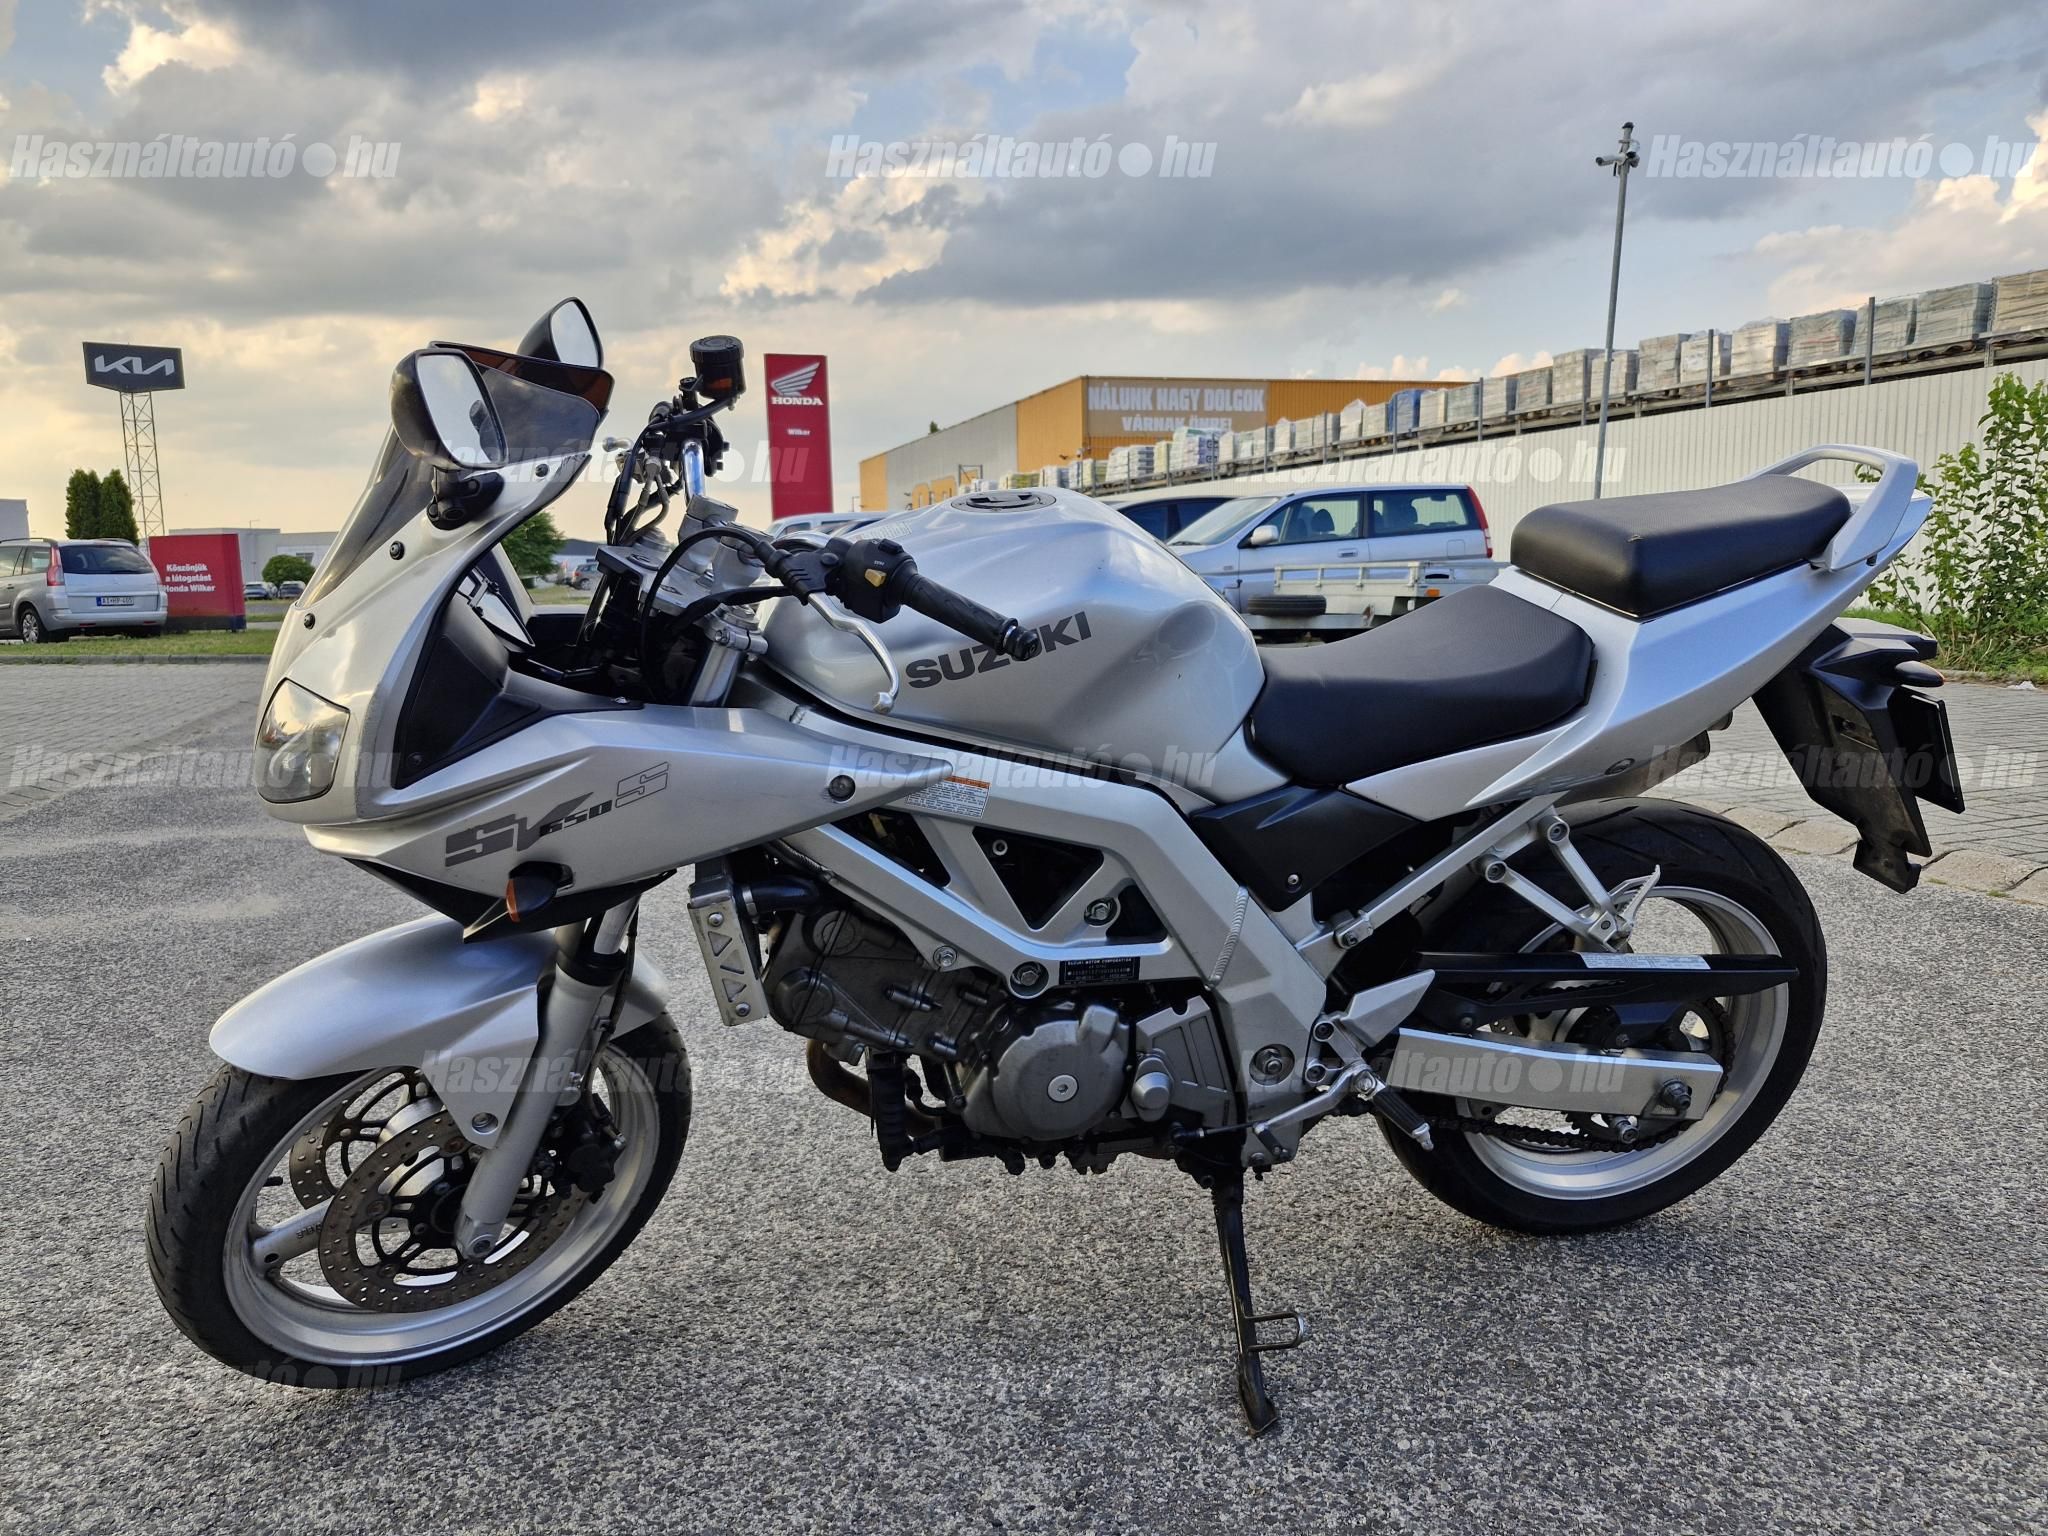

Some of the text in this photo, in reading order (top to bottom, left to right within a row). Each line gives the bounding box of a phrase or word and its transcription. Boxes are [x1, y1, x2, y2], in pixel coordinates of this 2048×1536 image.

[771, 397, 824, 406] HONDA
[1088, 382, 1152, 411] NÁLUNK
[1156, 388, 1200, 411] NAGY
[166, 564, 208, 573] Köszönjük
[905, 611, 1092, 688] SUZKI
